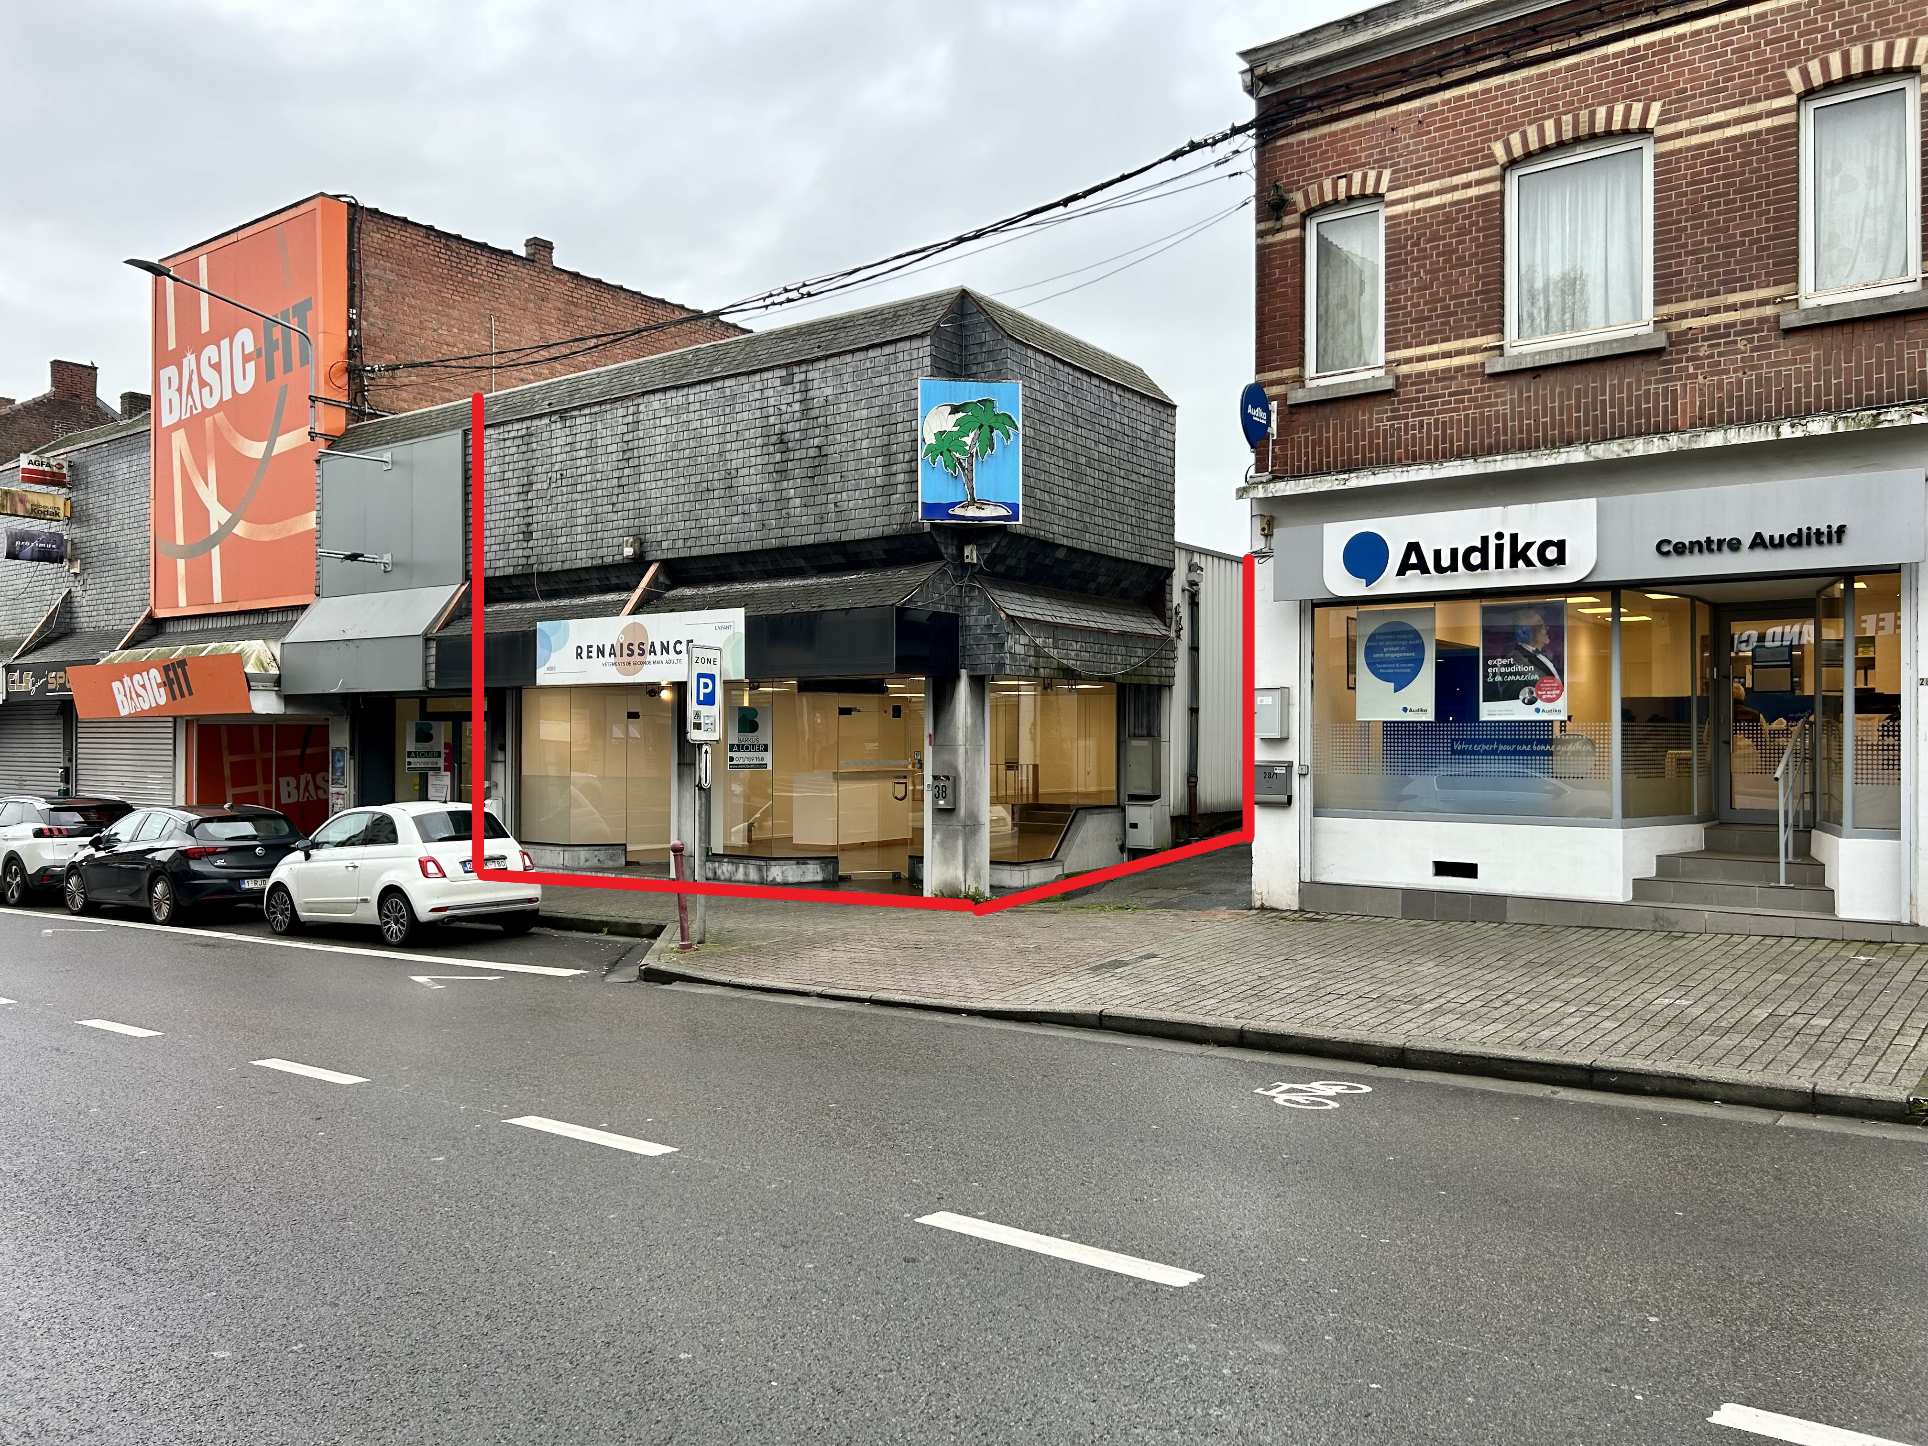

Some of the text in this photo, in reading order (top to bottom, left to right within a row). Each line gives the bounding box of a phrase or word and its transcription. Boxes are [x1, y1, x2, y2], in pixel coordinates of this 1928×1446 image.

[159, 297, 313, 428] BASIC-FIT
[1247, 404, 1267, 420] Audika
[27, 459, 52, 469] AGFA
[31, 506, 61, 518] Kodak
[15, 540, 57, 550] proximus
[1655, 525, 1847, 555] Centre Auditif
[1395, 531, 1566, 577] Audika
[694, 656, 718, 665] ZONE
[1487, 657, 1514, 667] expert
[1501, 665, 1534, 673] audition
[1504, 671, 1540, 682] connexion
[111, 658, 193, 716] BASIC-FIT
[700, 678, 713, 701] P
[740, 744, 765, 752] LOUER
[1453, 740, 1473, 751] Votre
[1473, 742, 1498, 753] expert
[1498, 742, 1517, 754] pour
[1532, 740, 1555, 751] bonne
[1263, 772, 1278, 780] 28/1
[934, 784, 947, 799] 38
